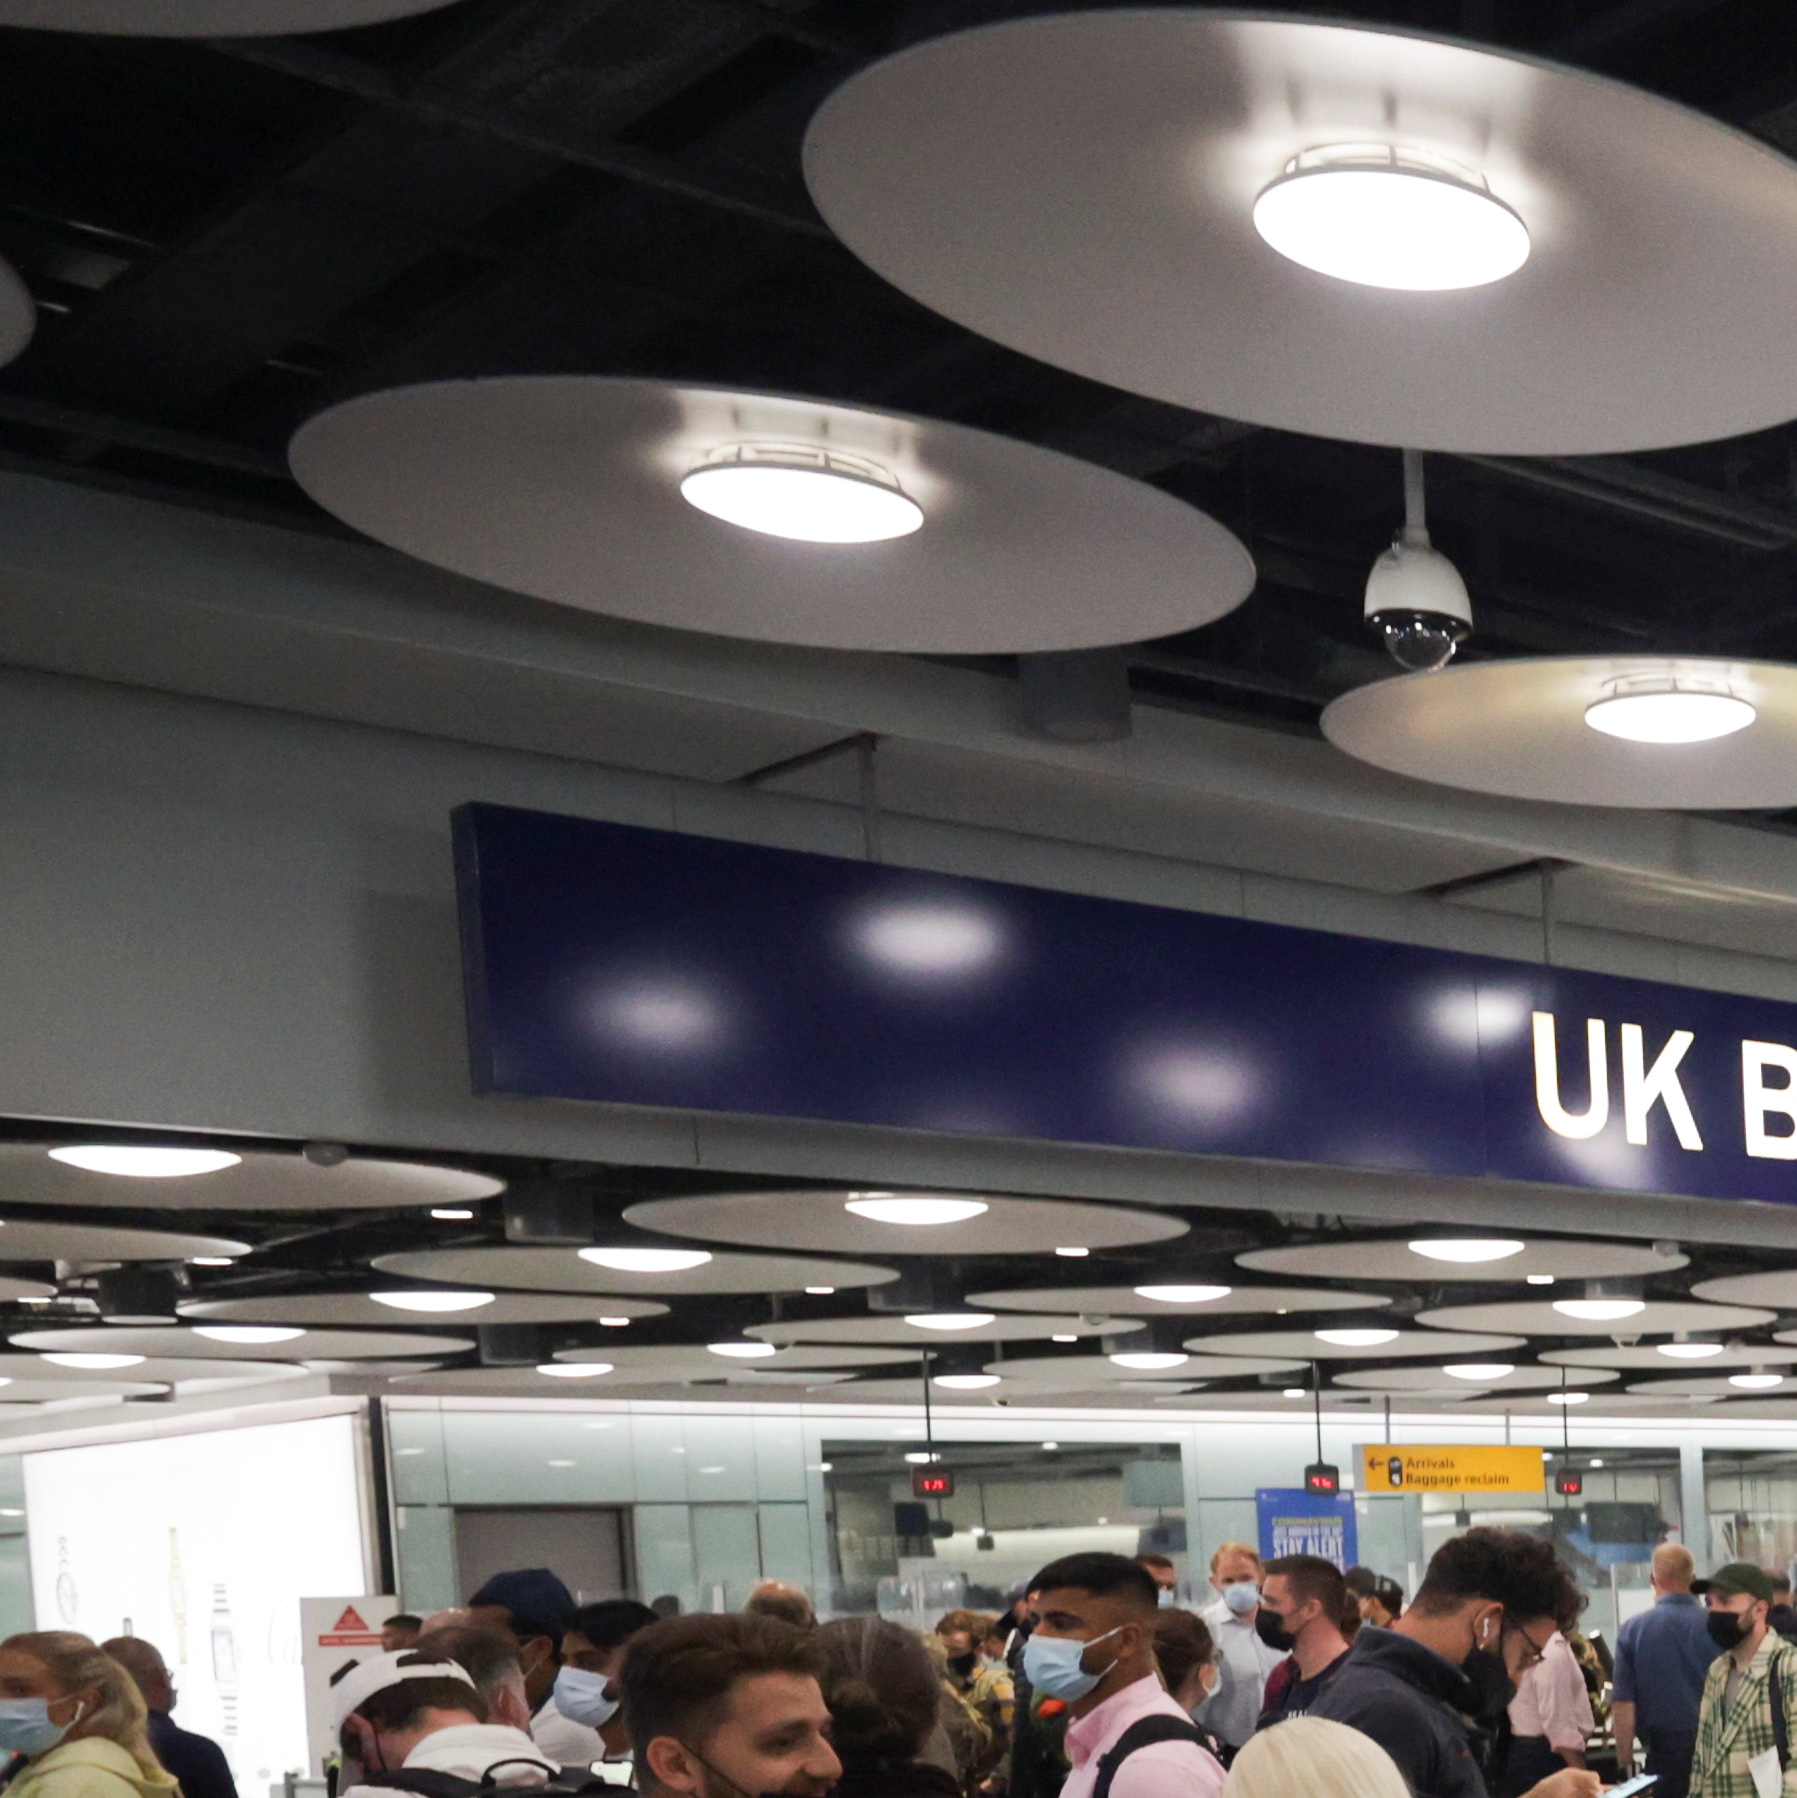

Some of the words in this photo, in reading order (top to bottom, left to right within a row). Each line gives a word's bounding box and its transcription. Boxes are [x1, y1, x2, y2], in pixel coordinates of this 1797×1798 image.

[1532, 1011, 1703, 1152] UK
[1406, 1457, 1455, 1469] Arrivals
[1406, 1473, 1461, 1487] Baggage
[1464, 1474, 1509, 1485] reclaim
[1273, 1537, 1303, 1558] STAY
[1306, 1535, 1342, 1557] ALERT
